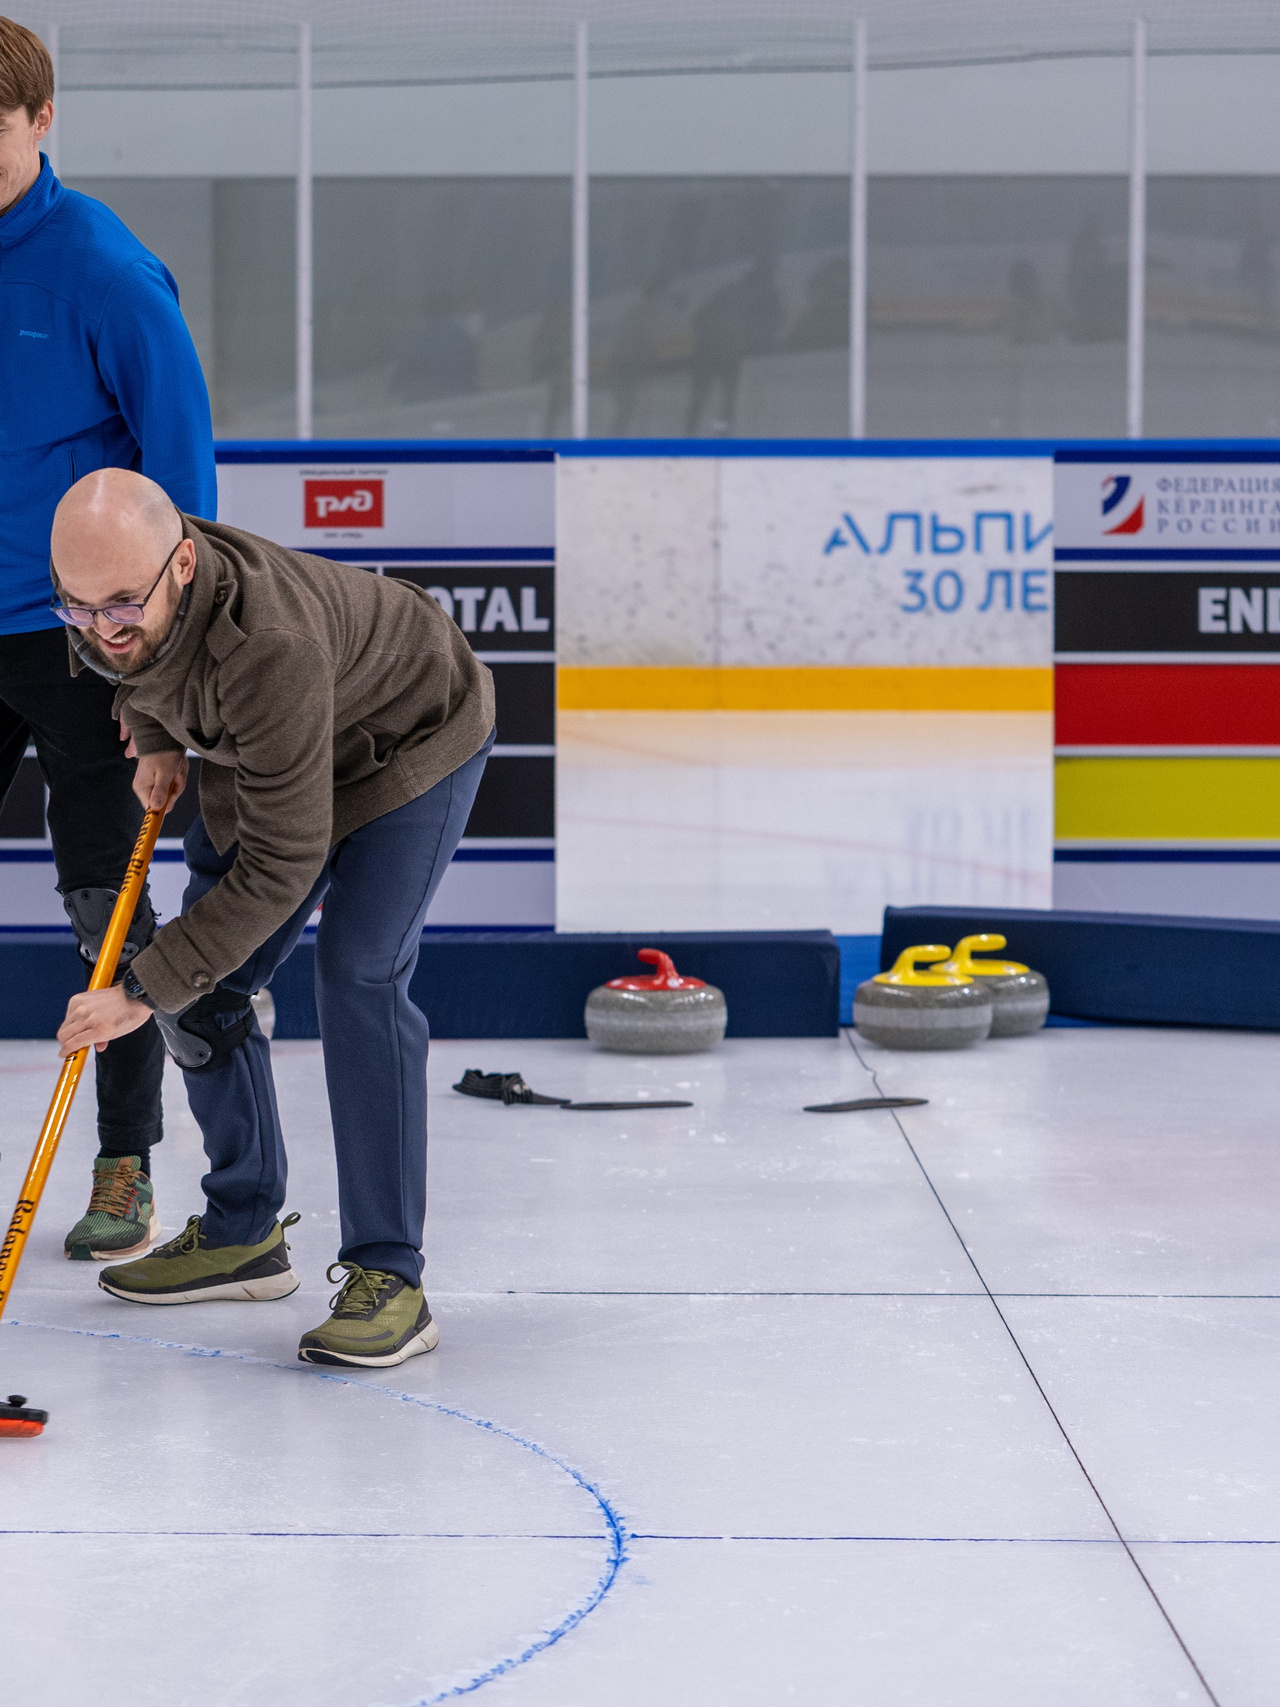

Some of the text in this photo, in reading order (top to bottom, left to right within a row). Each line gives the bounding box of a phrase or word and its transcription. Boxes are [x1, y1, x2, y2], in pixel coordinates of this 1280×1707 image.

[823, 513, 1053, 554] АЛЬПИ
[901, 569, 1048, 613] 30 ЛЕ
